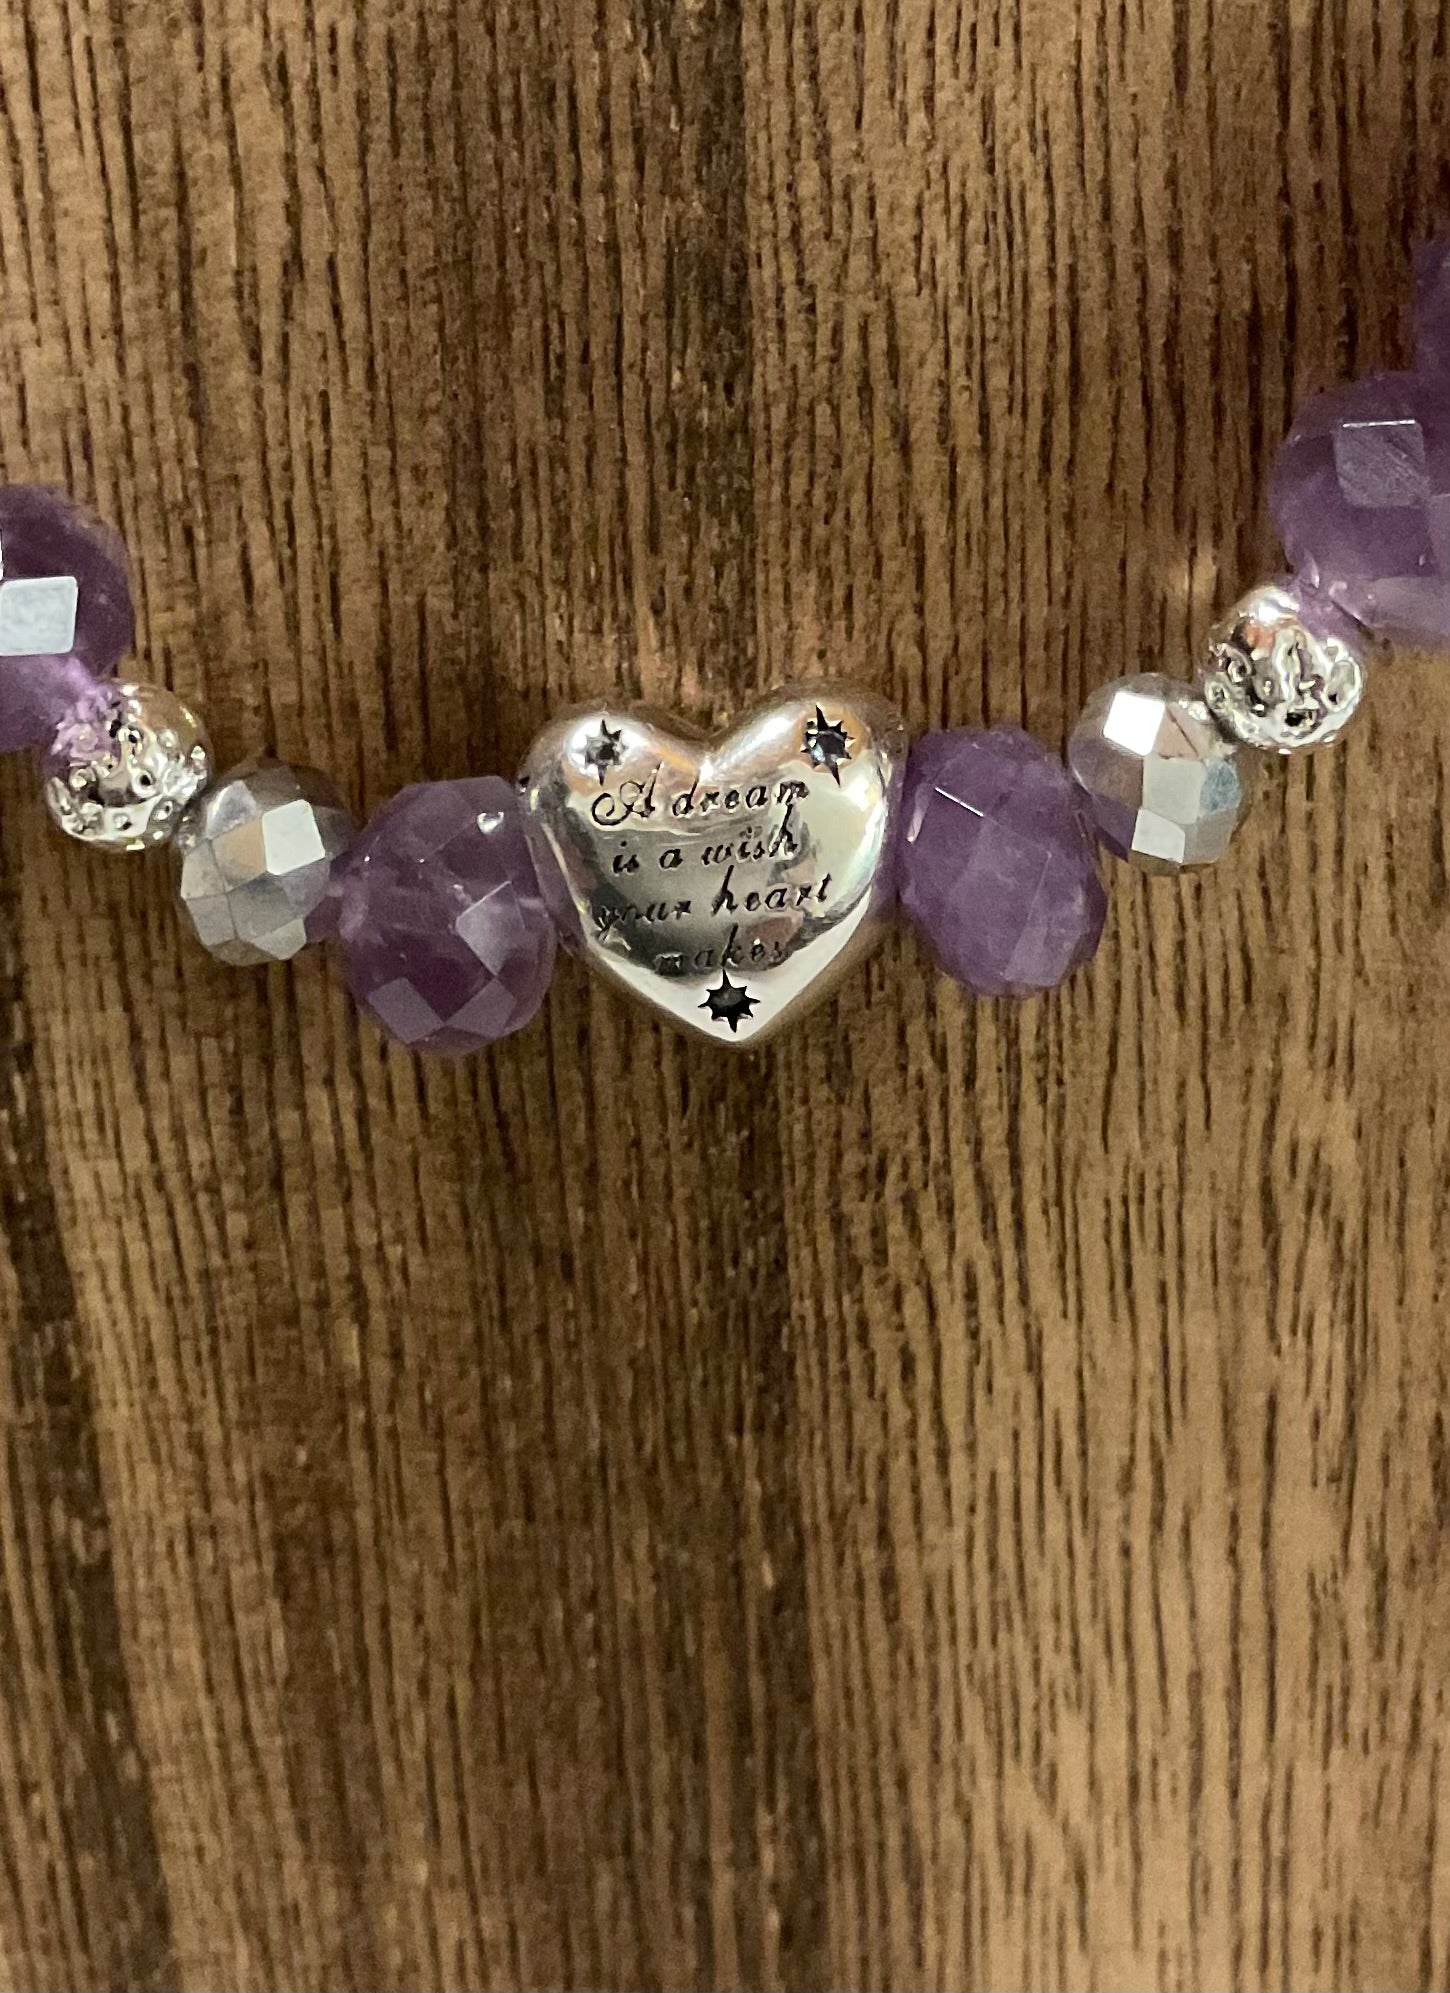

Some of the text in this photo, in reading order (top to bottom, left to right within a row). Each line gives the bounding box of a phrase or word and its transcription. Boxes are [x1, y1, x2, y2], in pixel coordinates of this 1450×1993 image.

[591, 764, 810, 826] A dream
[612, 803, 798, 874] is a wish
[596, 864, 832, 941] your heart
[655, 923, 783, 976] makes
